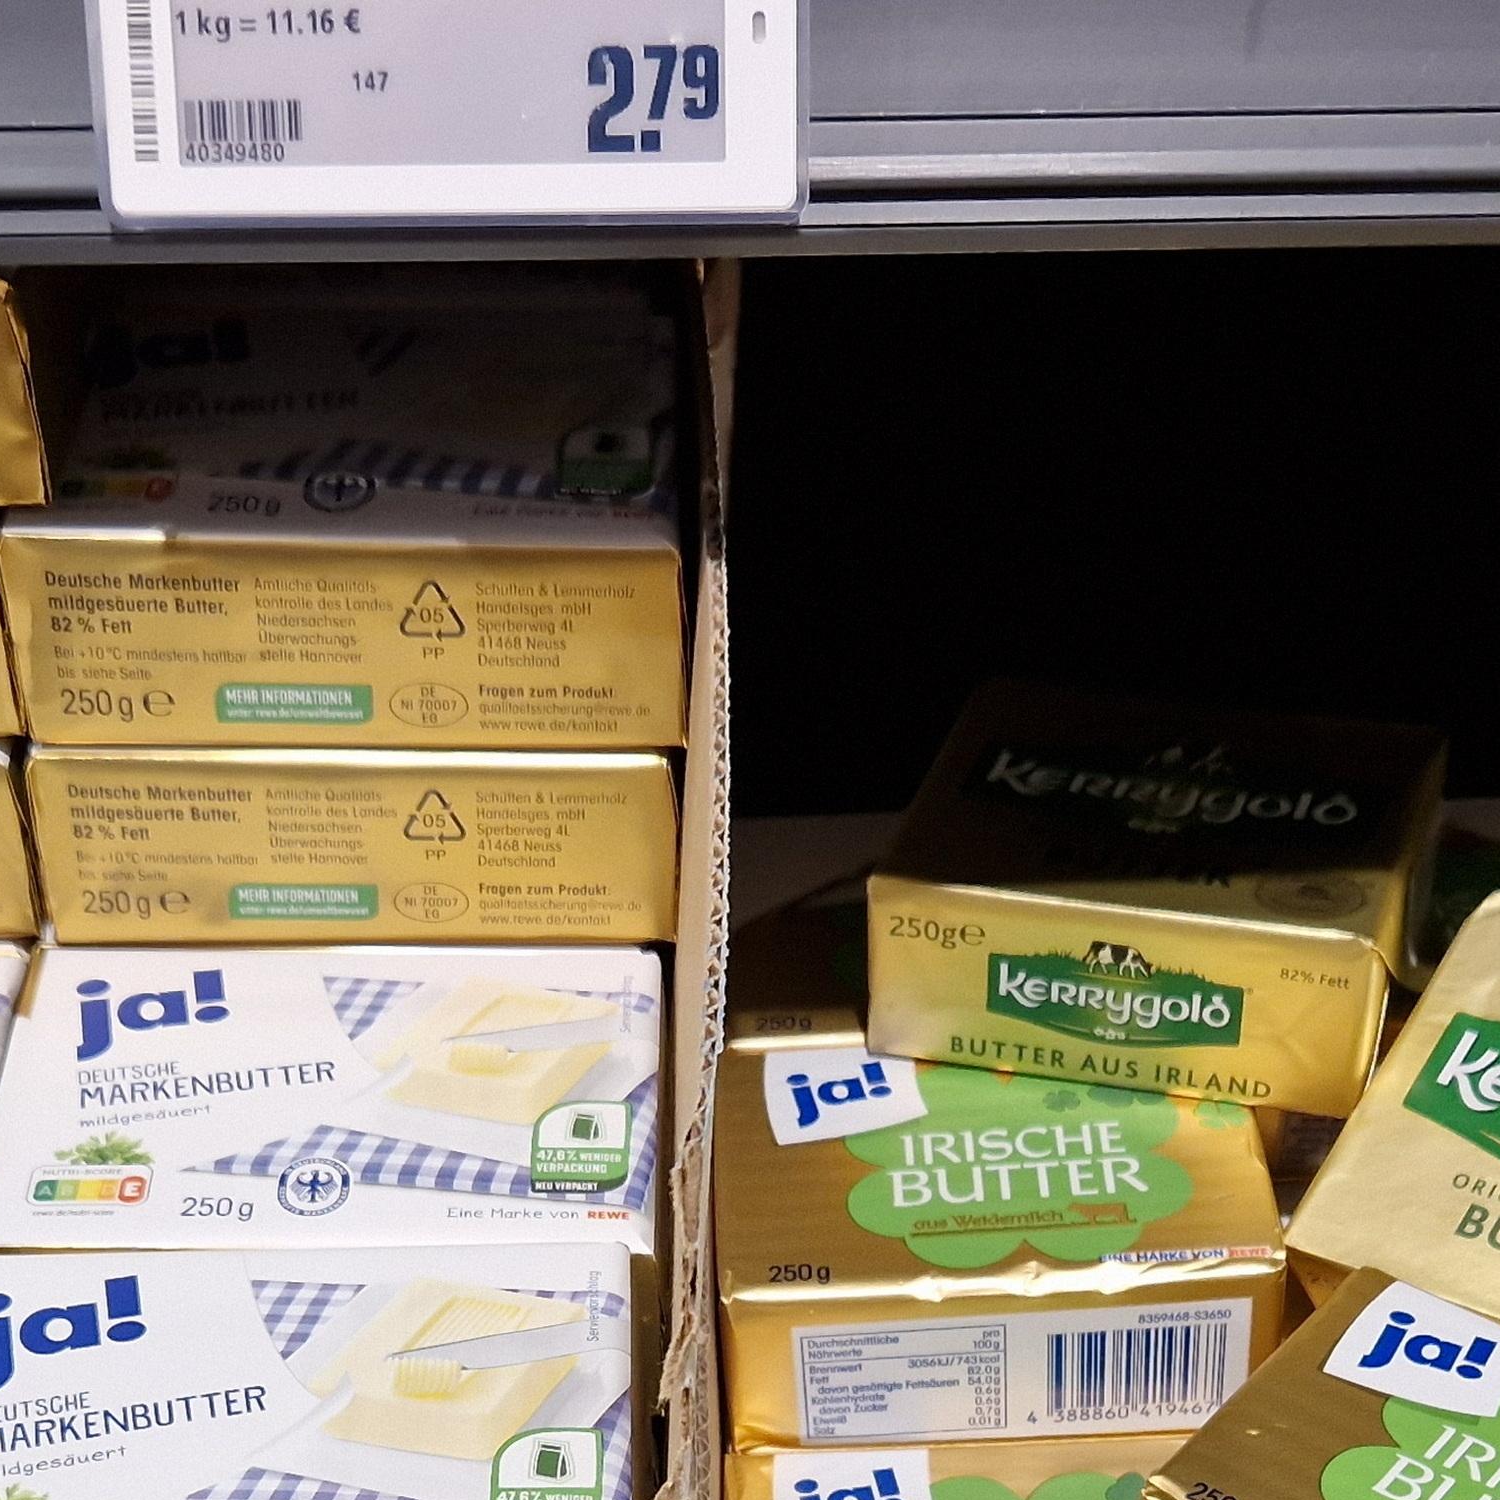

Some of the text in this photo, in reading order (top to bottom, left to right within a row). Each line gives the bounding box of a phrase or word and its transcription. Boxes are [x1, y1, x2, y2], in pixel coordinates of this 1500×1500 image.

[176, 9, 359, 42] 1 kg = 11.16 €
[352, 71, 388, 92] 147
[588, 45, 720, 152] 2.79
[186, 143, 285, 162] 40349480
[45, 570, 240, 594] Deutsche Markenbutter
[998, 964, 1231, 1030] Kerrygold
[1280, 968, 1350, 990] 82% Fett
[76, 970, 230, 1061] ja!
[79, 1061, 180, 1084] DEUTSCHE
[80, 1061, 335, 1109] MARKENBUTTER
[950, 1035, 1271, 1099] BUTTER AUS IRLAND
[786, 1062, 891, 1126] ja!
[900, 1122, 1126, 1165] IRISCHE
[888, 1154, 1149, 1206] BUTTER
[1359, 1310, 1494, 1381] ja!
